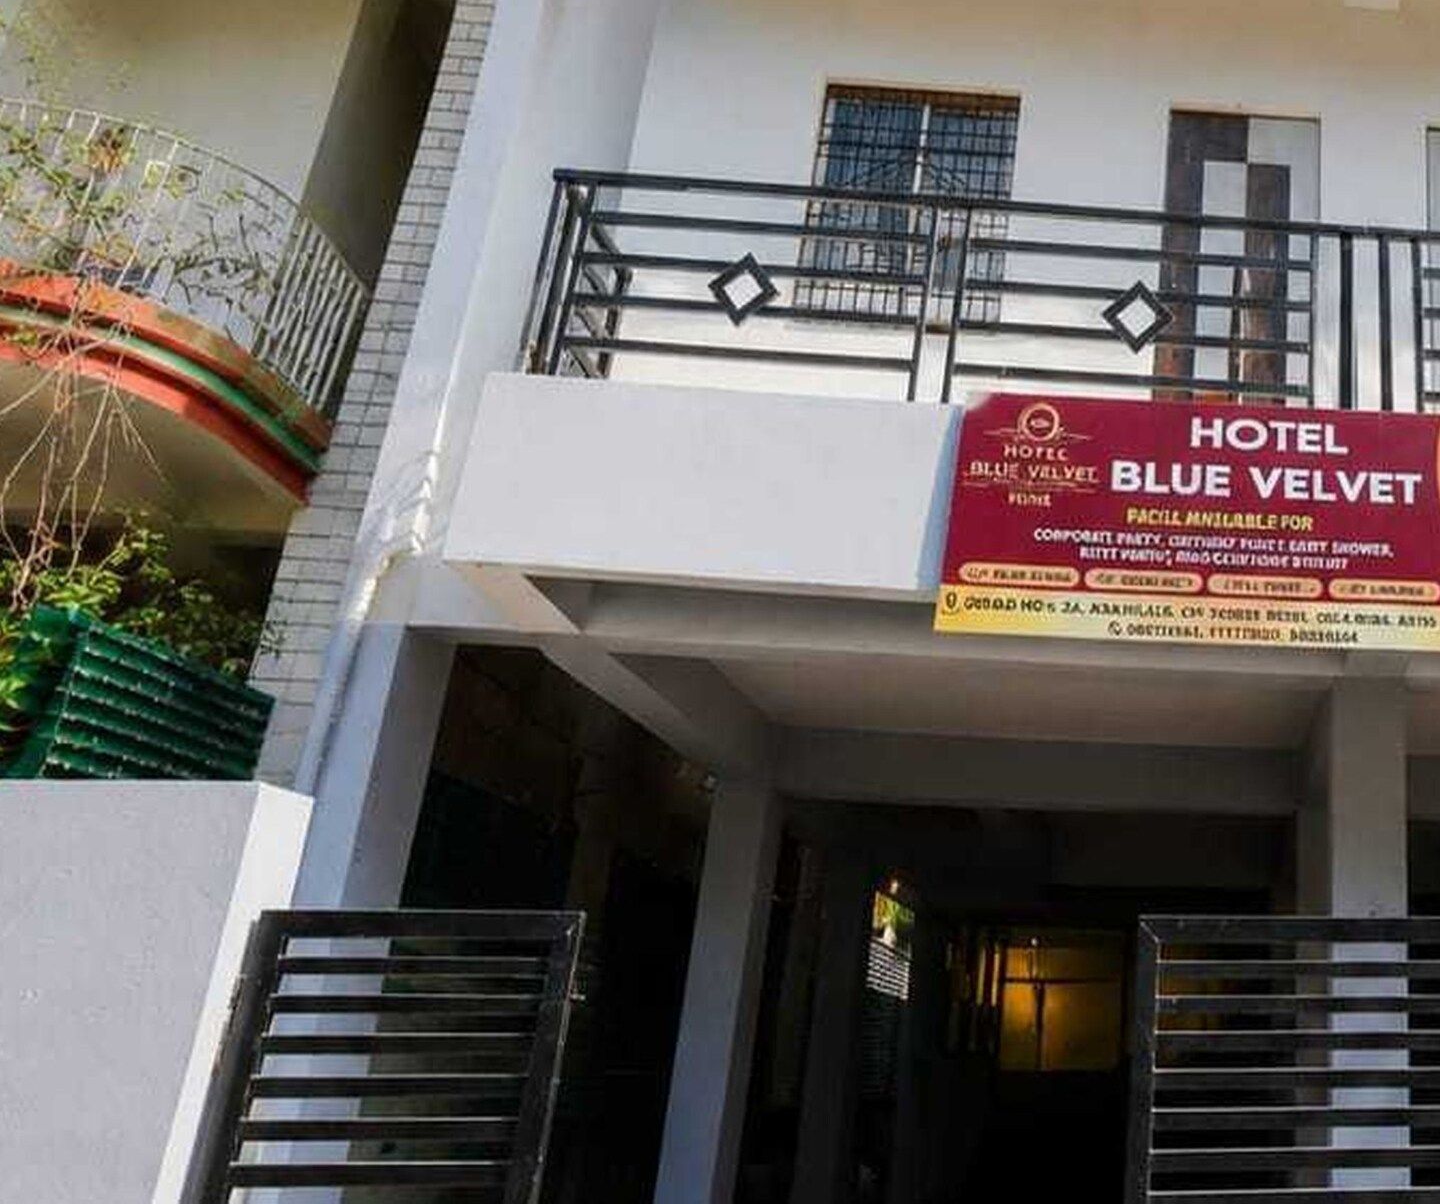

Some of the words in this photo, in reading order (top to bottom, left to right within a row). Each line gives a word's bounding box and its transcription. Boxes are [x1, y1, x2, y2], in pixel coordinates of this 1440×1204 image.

[1190, 416, 1349, 454] HOTEL
[970, 460, 1020, 479] BLUE
[1111, 459, 1232, 498] BLUE
[1249, 465, 1422, 504] VELVET
[1280, 514, 1314, 531] FOR
